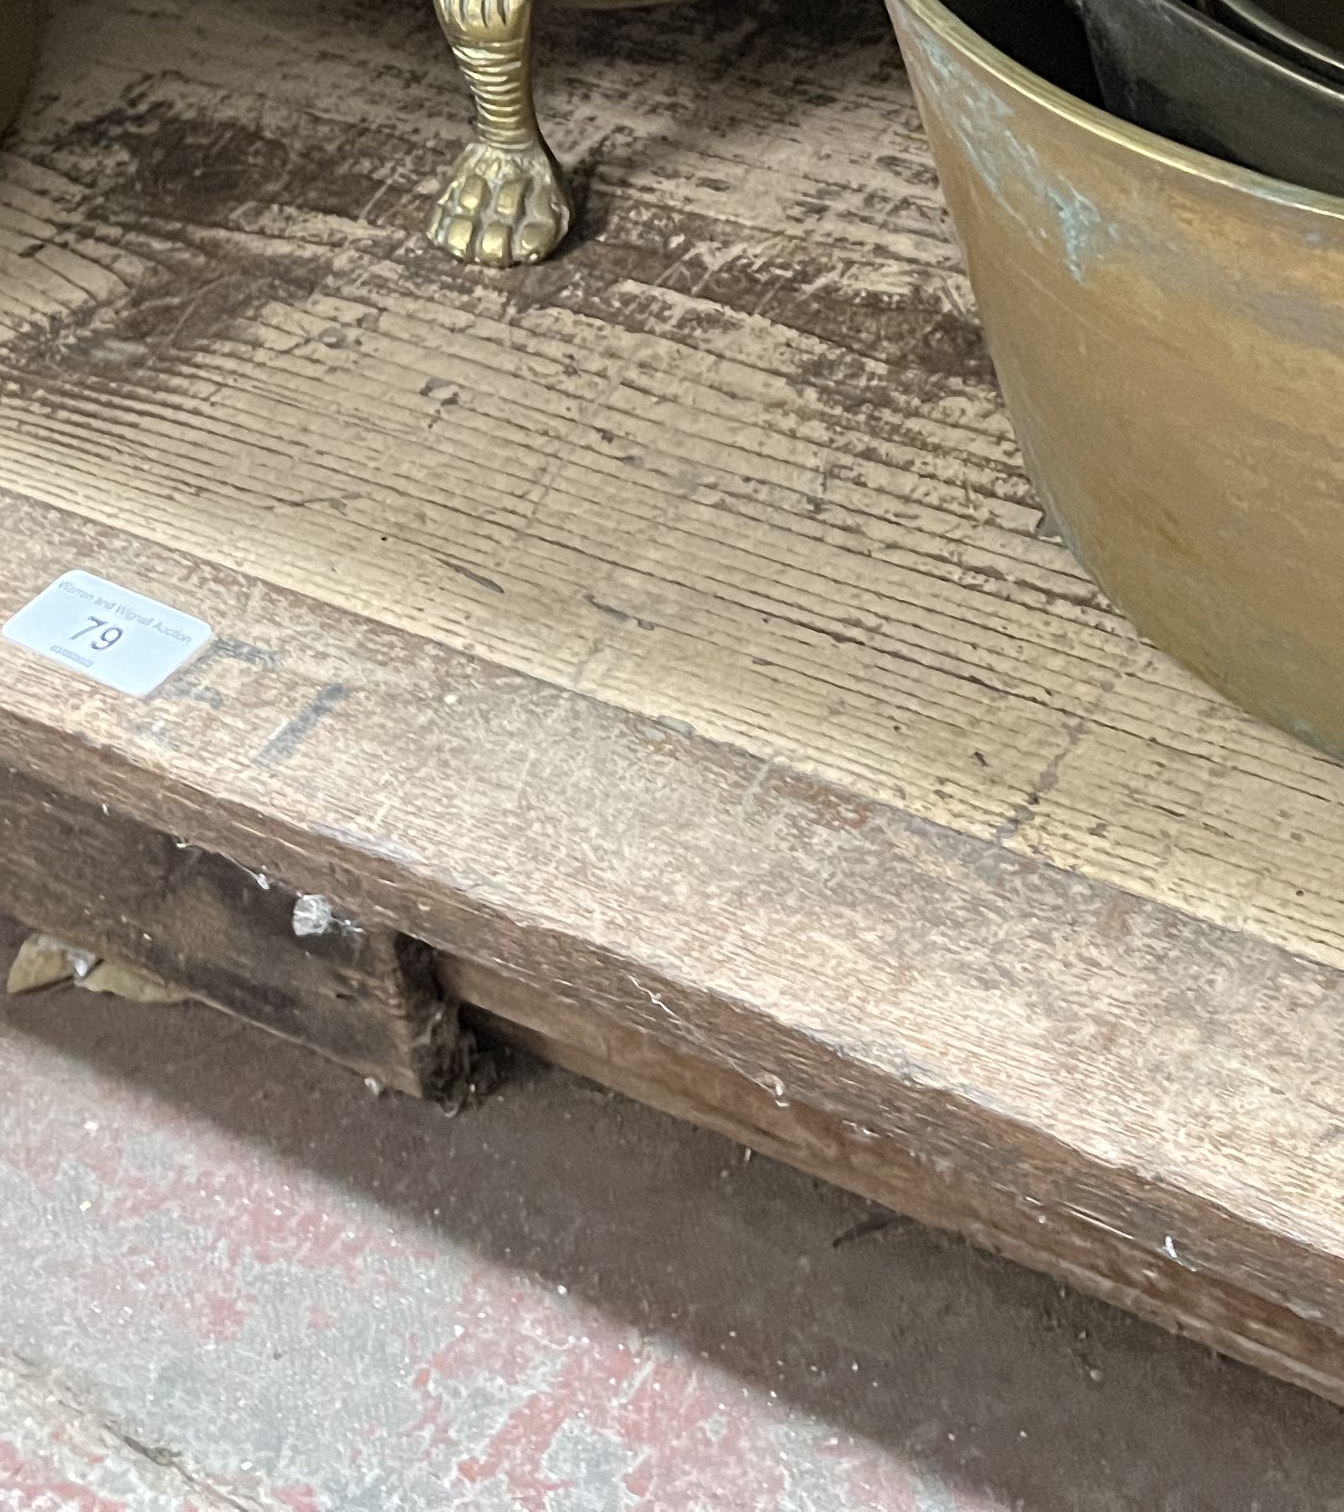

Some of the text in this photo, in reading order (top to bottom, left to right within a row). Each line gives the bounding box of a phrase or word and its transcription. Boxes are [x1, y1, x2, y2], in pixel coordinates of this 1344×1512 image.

[58, 580, 94, 600] Warren
[94, 594, 116, 610] and
[153, 622, 192, 643] Auction
[70, 616, 124, 651] 79
